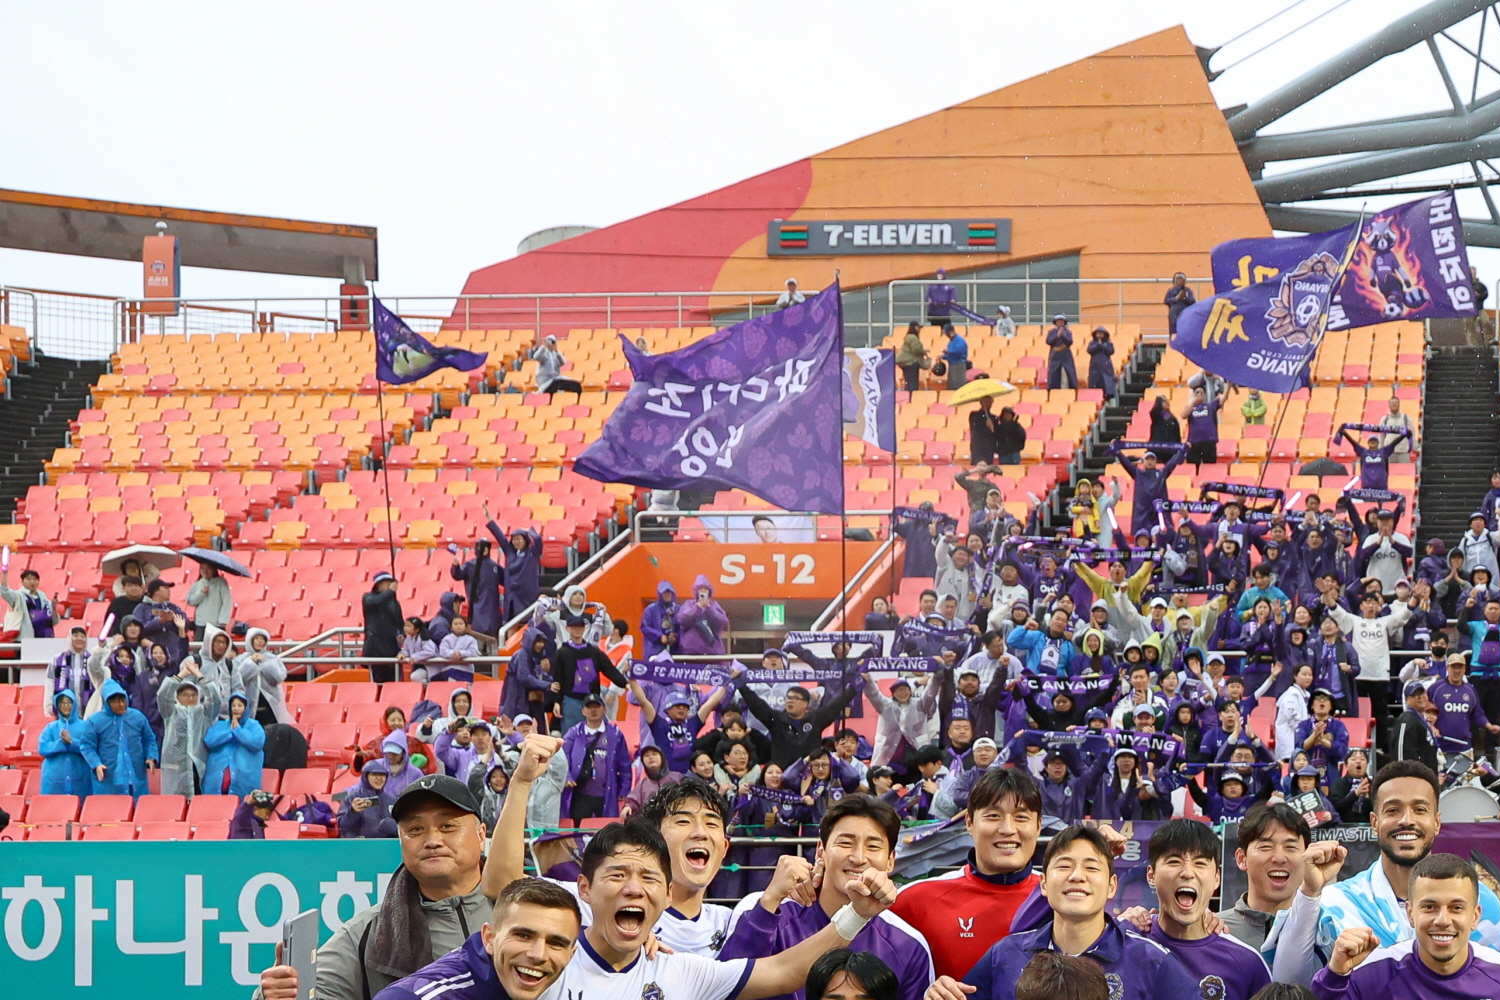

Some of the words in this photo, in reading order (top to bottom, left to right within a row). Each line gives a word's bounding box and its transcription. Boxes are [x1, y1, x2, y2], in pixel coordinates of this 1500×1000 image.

[1226, 484, 1275, 498] ANYANG
[1156, 501, 1170, 512] FC
[1172, 502, 1218, 514] ANYANG
[719, 553, 816, 585] S-12
[1360, 630, 1383, 638] OHC
[867, 658, 929, 670] ANYANG
[653, 665, 666, 677] FC
[668, 666, 711, 681] ANYANG
[1041, 677, 1111, 691] ANYANG
[1444, 702, 1469, 713] OHC
[1094, 729, 1176, 751] ANYANG
[1318, 827, 1379, 842] MASTE
